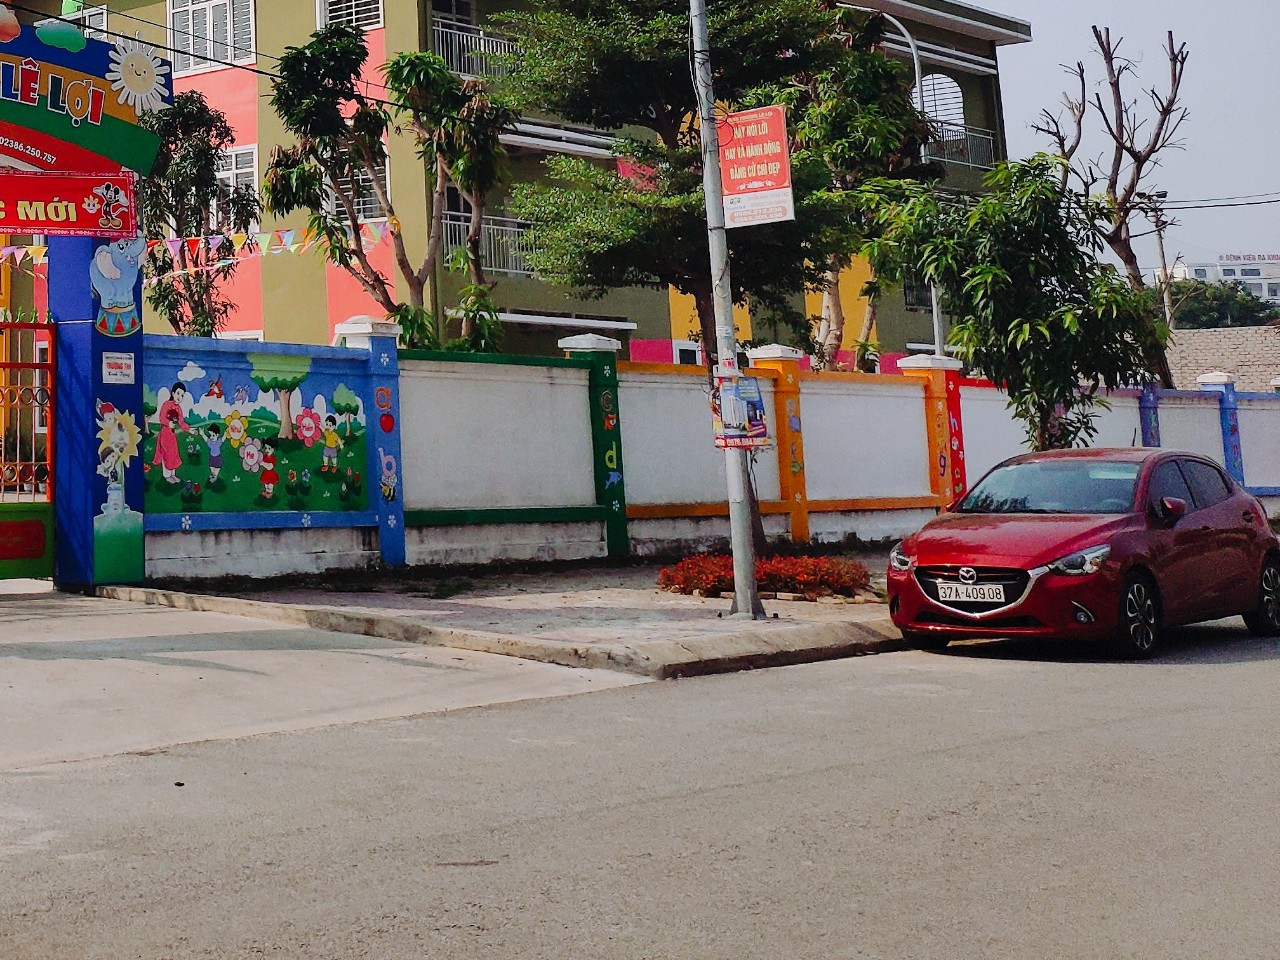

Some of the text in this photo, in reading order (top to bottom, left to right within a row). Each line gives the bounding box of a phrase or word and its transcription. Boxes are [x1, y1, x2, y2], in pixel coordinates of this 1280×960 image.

[0, 57, 40, 106] LÊ
[47, 73, 106, 127] LỢI
[16, 196, 77, 223] MỚI
[375, 387, 391, 411] a
[378, 448, 396, 476] b
[605, 441, 616, 468] d
